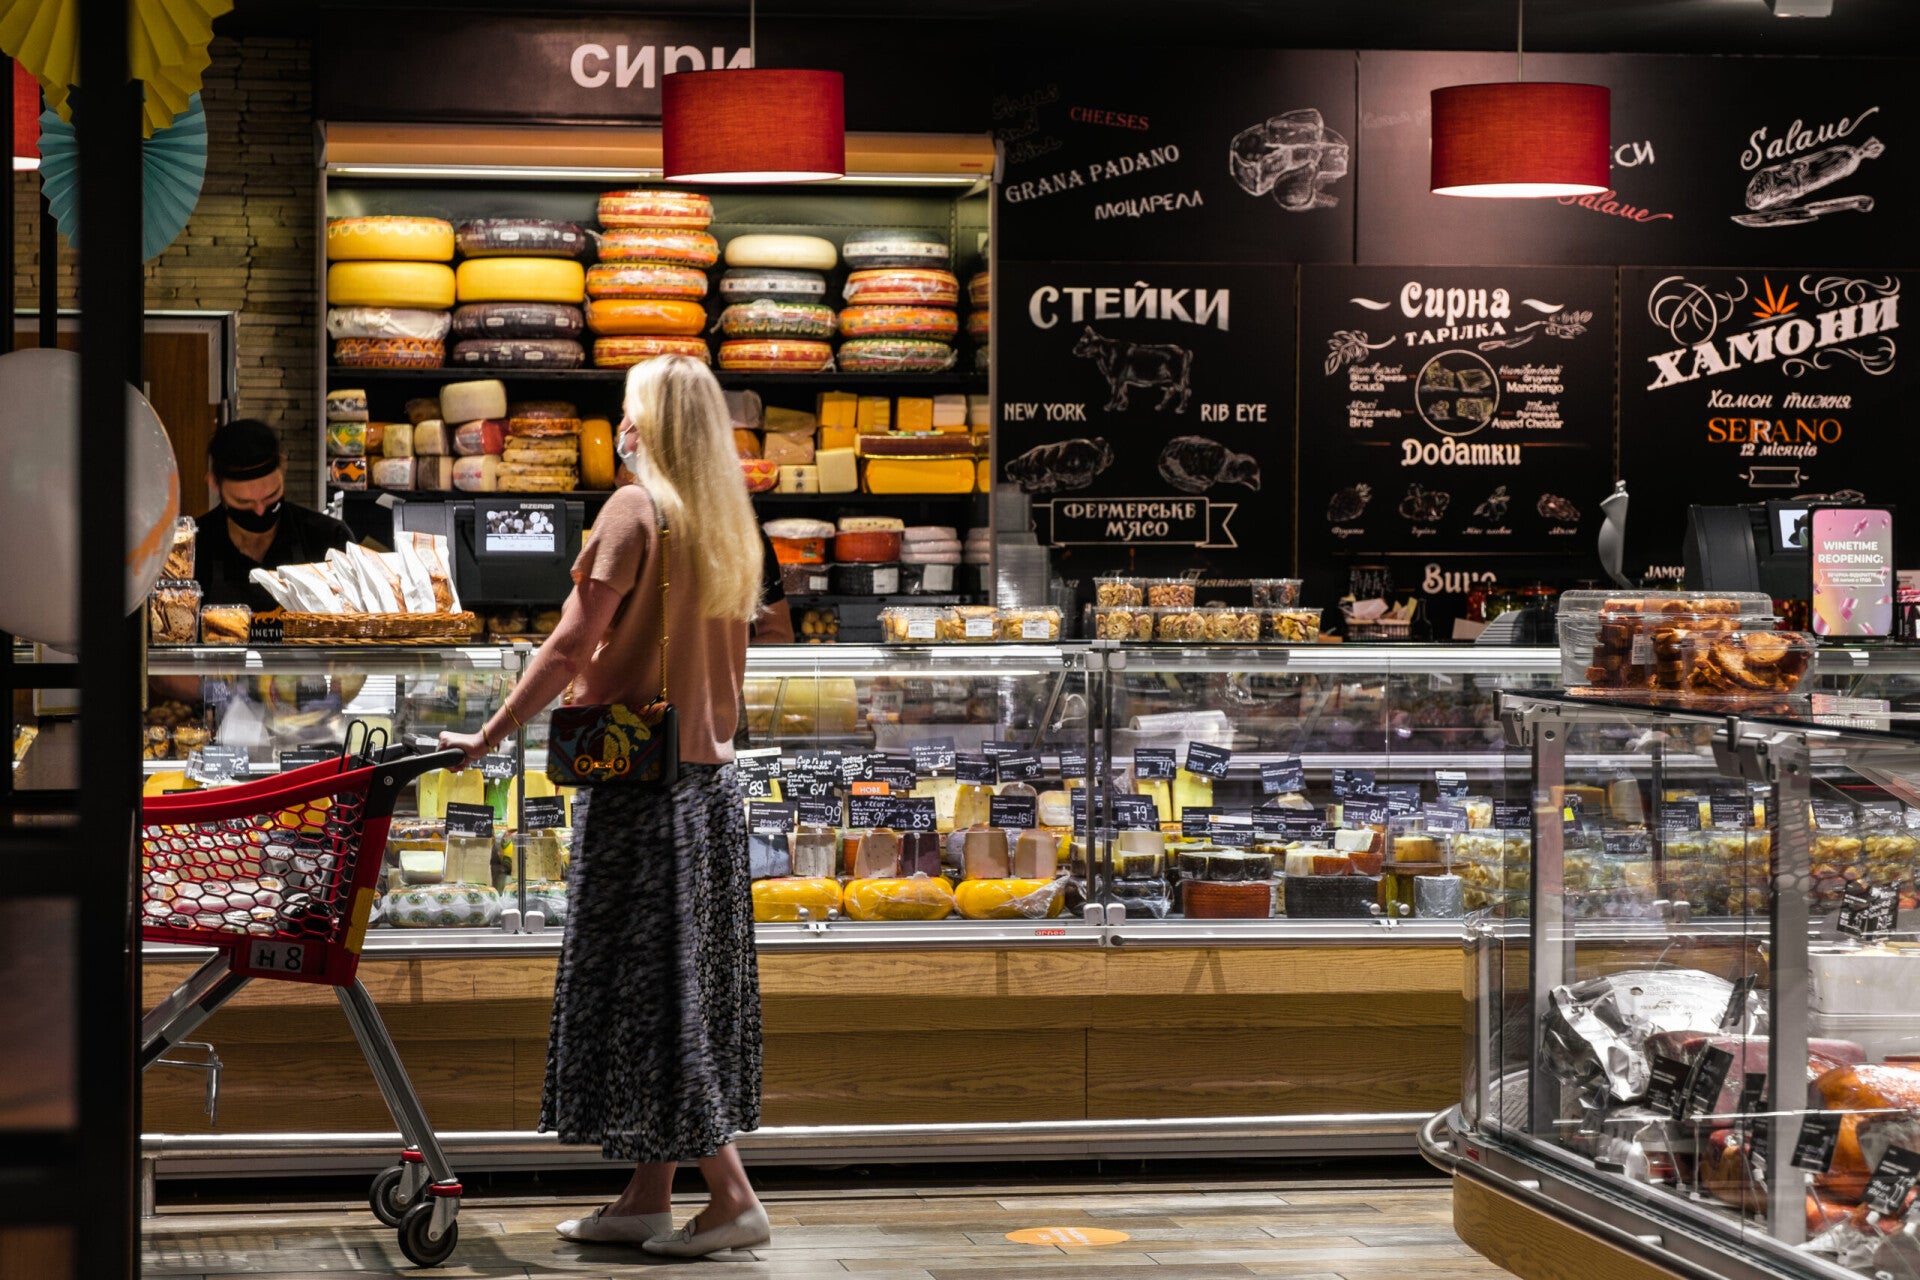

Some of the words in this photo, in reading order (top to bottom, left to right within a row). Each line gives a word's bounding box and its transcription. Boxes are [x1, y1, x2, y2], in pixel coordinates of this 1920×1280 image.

[1069, 105, 1149, 131] CHEESES
[1004, 168, 1085, 204] GRANA
[1089, 143, 1181, 183] PADANO
[1028, 280, 1230, 331] СТЕЙКИ
[1400, 281, 1511, 327] Сирна
[1404, 321, 1507, 347] ТАРІЛКА
[1647, 294, 1900, 391] ХАМОНИ
[1349, 380, 1385, 392] Gouda
[1707, 389, 1773, 409] Хамон
[1782, 391, 1852, 410] тижня
[1003, 403, 1038, 422] NEW
[1042, 403, 1087, 422] YORK
[1200, 403, 1230, 422] RIB
[1236, 403, 1267, 423] EYE
[1349, 416, 1374, 429] Brie
[1401, 436, 1522, 467] Додатки
[1739, 443, 1755, 457] 12
[1063, 503, 1197, 521] ФЕРМЕРСЬКЕ
[1823, 541, 1878, 551] WINETIME
[1817, 553, 1884, 564] REOPENING:
[809, 783, 828, 796] 64
[913, 813, 931, 829] 83
[284, 946, 302, 971] 8
